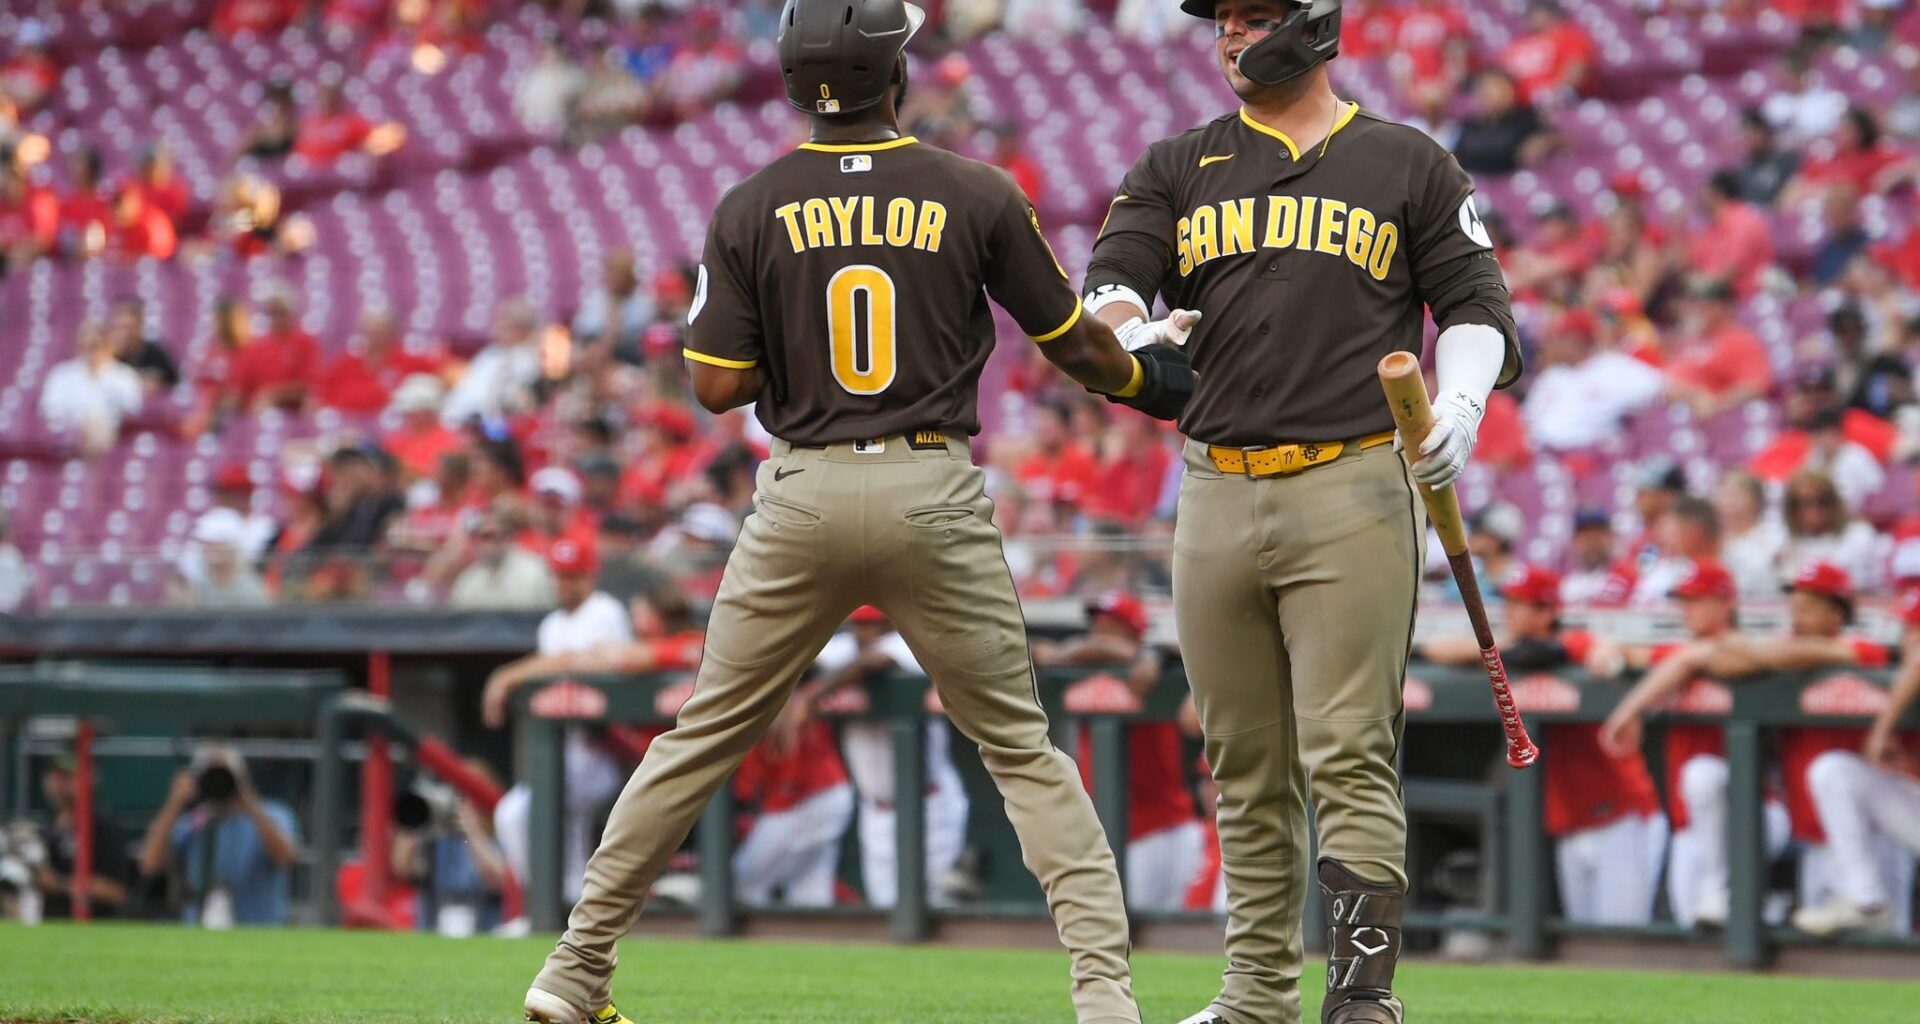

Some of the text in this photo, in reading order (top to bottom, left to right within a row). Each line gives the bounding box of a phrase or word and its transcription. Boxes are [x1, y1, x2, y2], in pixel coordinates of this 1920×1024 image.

[820, 83, 830, 99] 0
[775, 196, 948, 254] TAYLOR
[1176, 195, 1399, 281] SAN DIEGO
[826, 264, 897, 396] 0
[1283, 450, 1296, 465] TY
